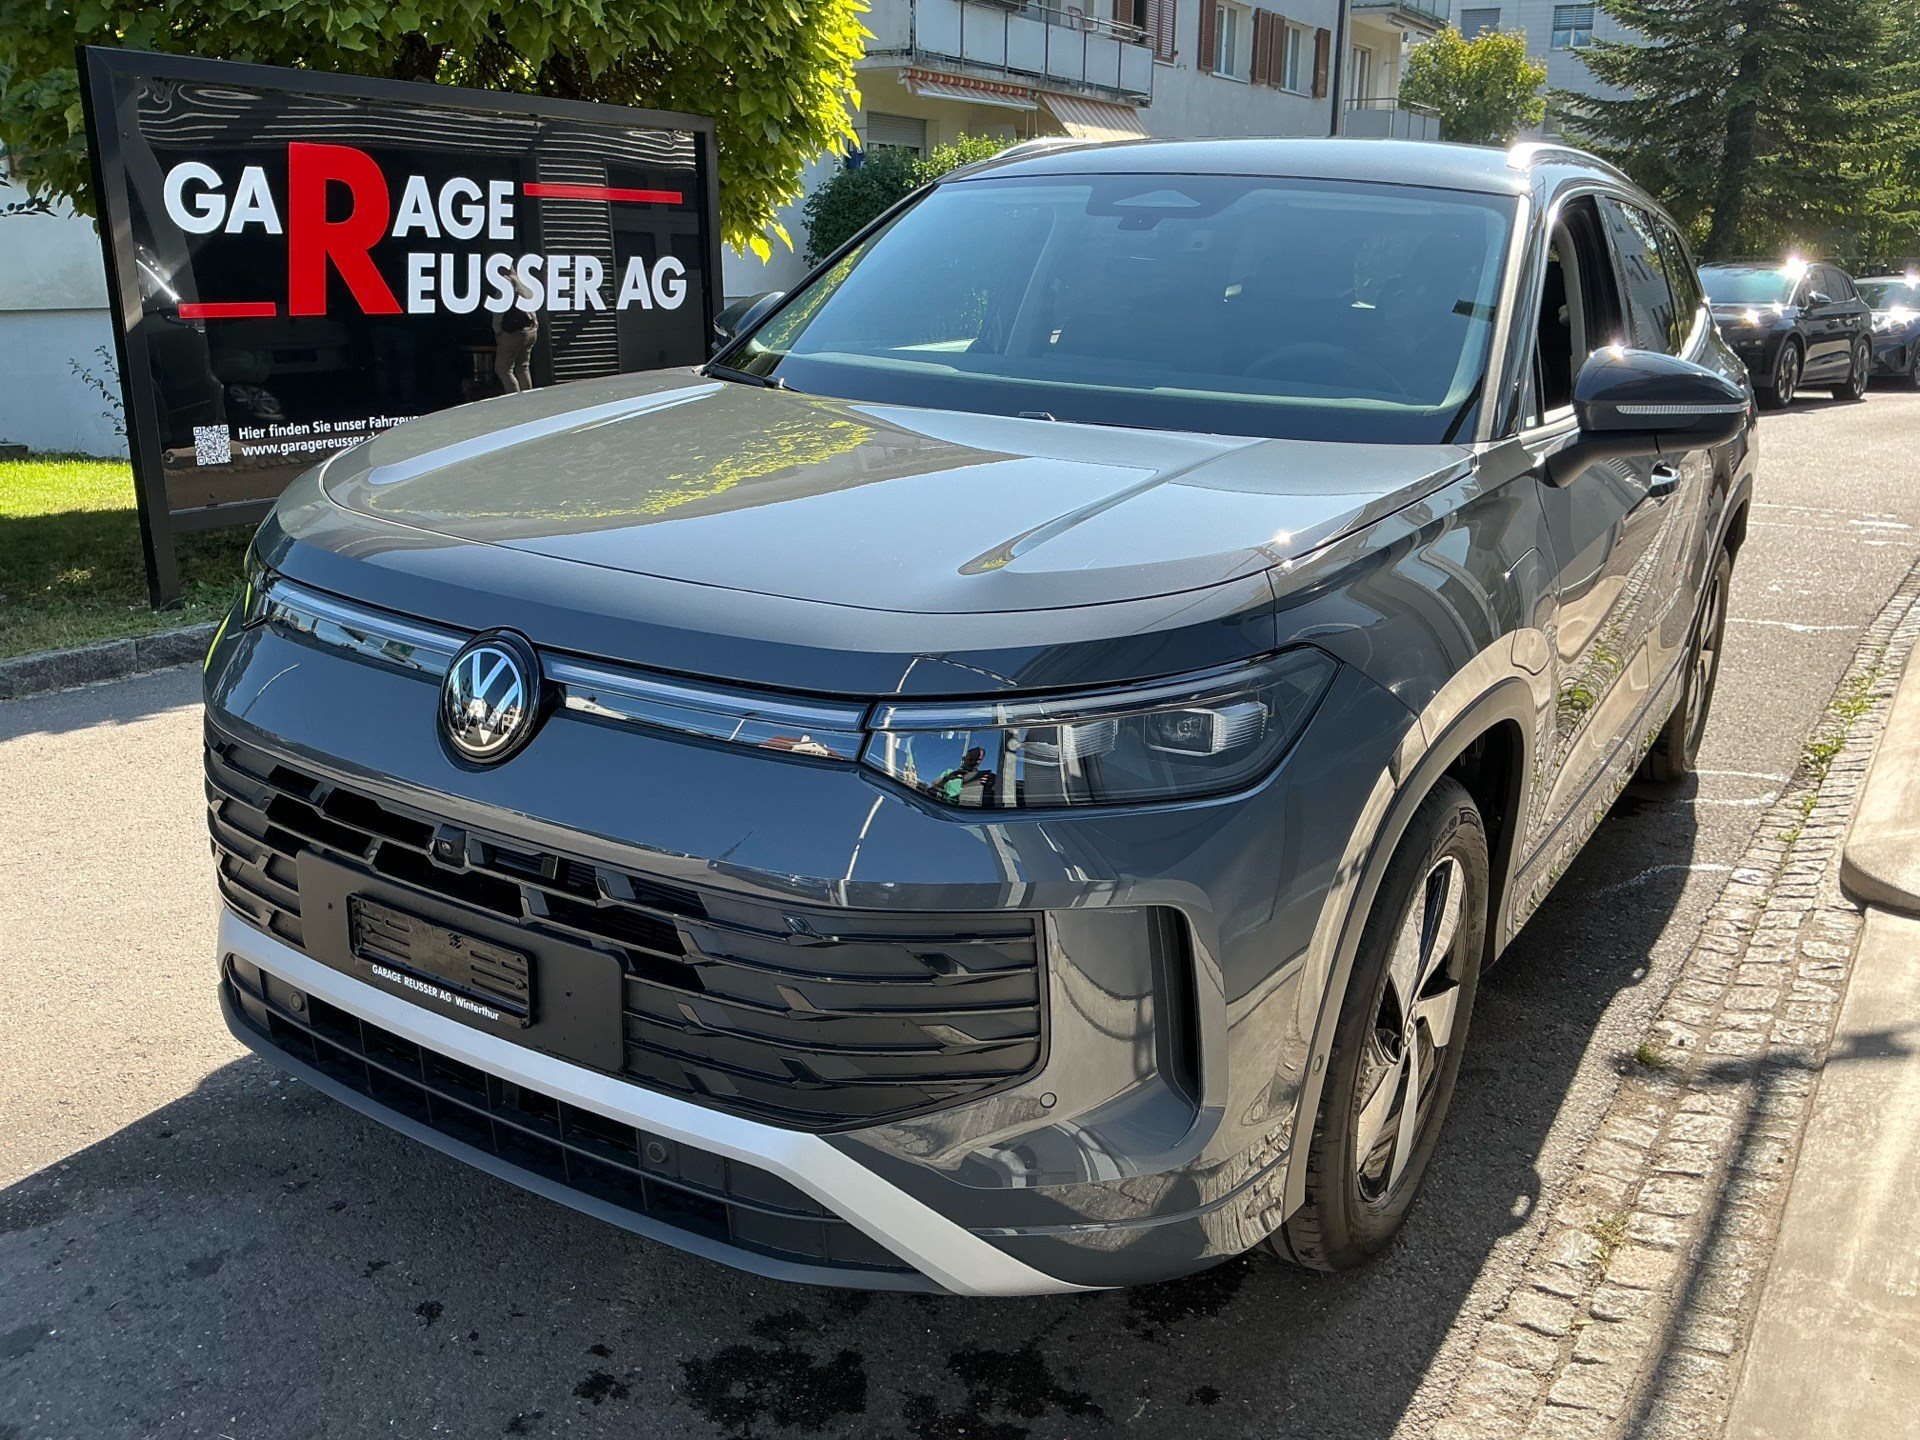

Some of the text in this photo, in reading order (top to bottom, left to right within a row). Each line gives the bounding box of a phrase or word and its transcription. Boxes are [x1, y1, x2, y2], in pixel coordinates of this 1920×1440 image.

[163, 142, 515, 316] GARAGE
[617, 256, 688, 311] AG
[239, 426, 266, 440] Hier
[269, 422, 310, 438] finden
[312, 420, 331, 434] Sie
[334, 419, 367, 431] unser
[372, 964, 500, 1021] GARAGE REUSSER AG Winterthur
